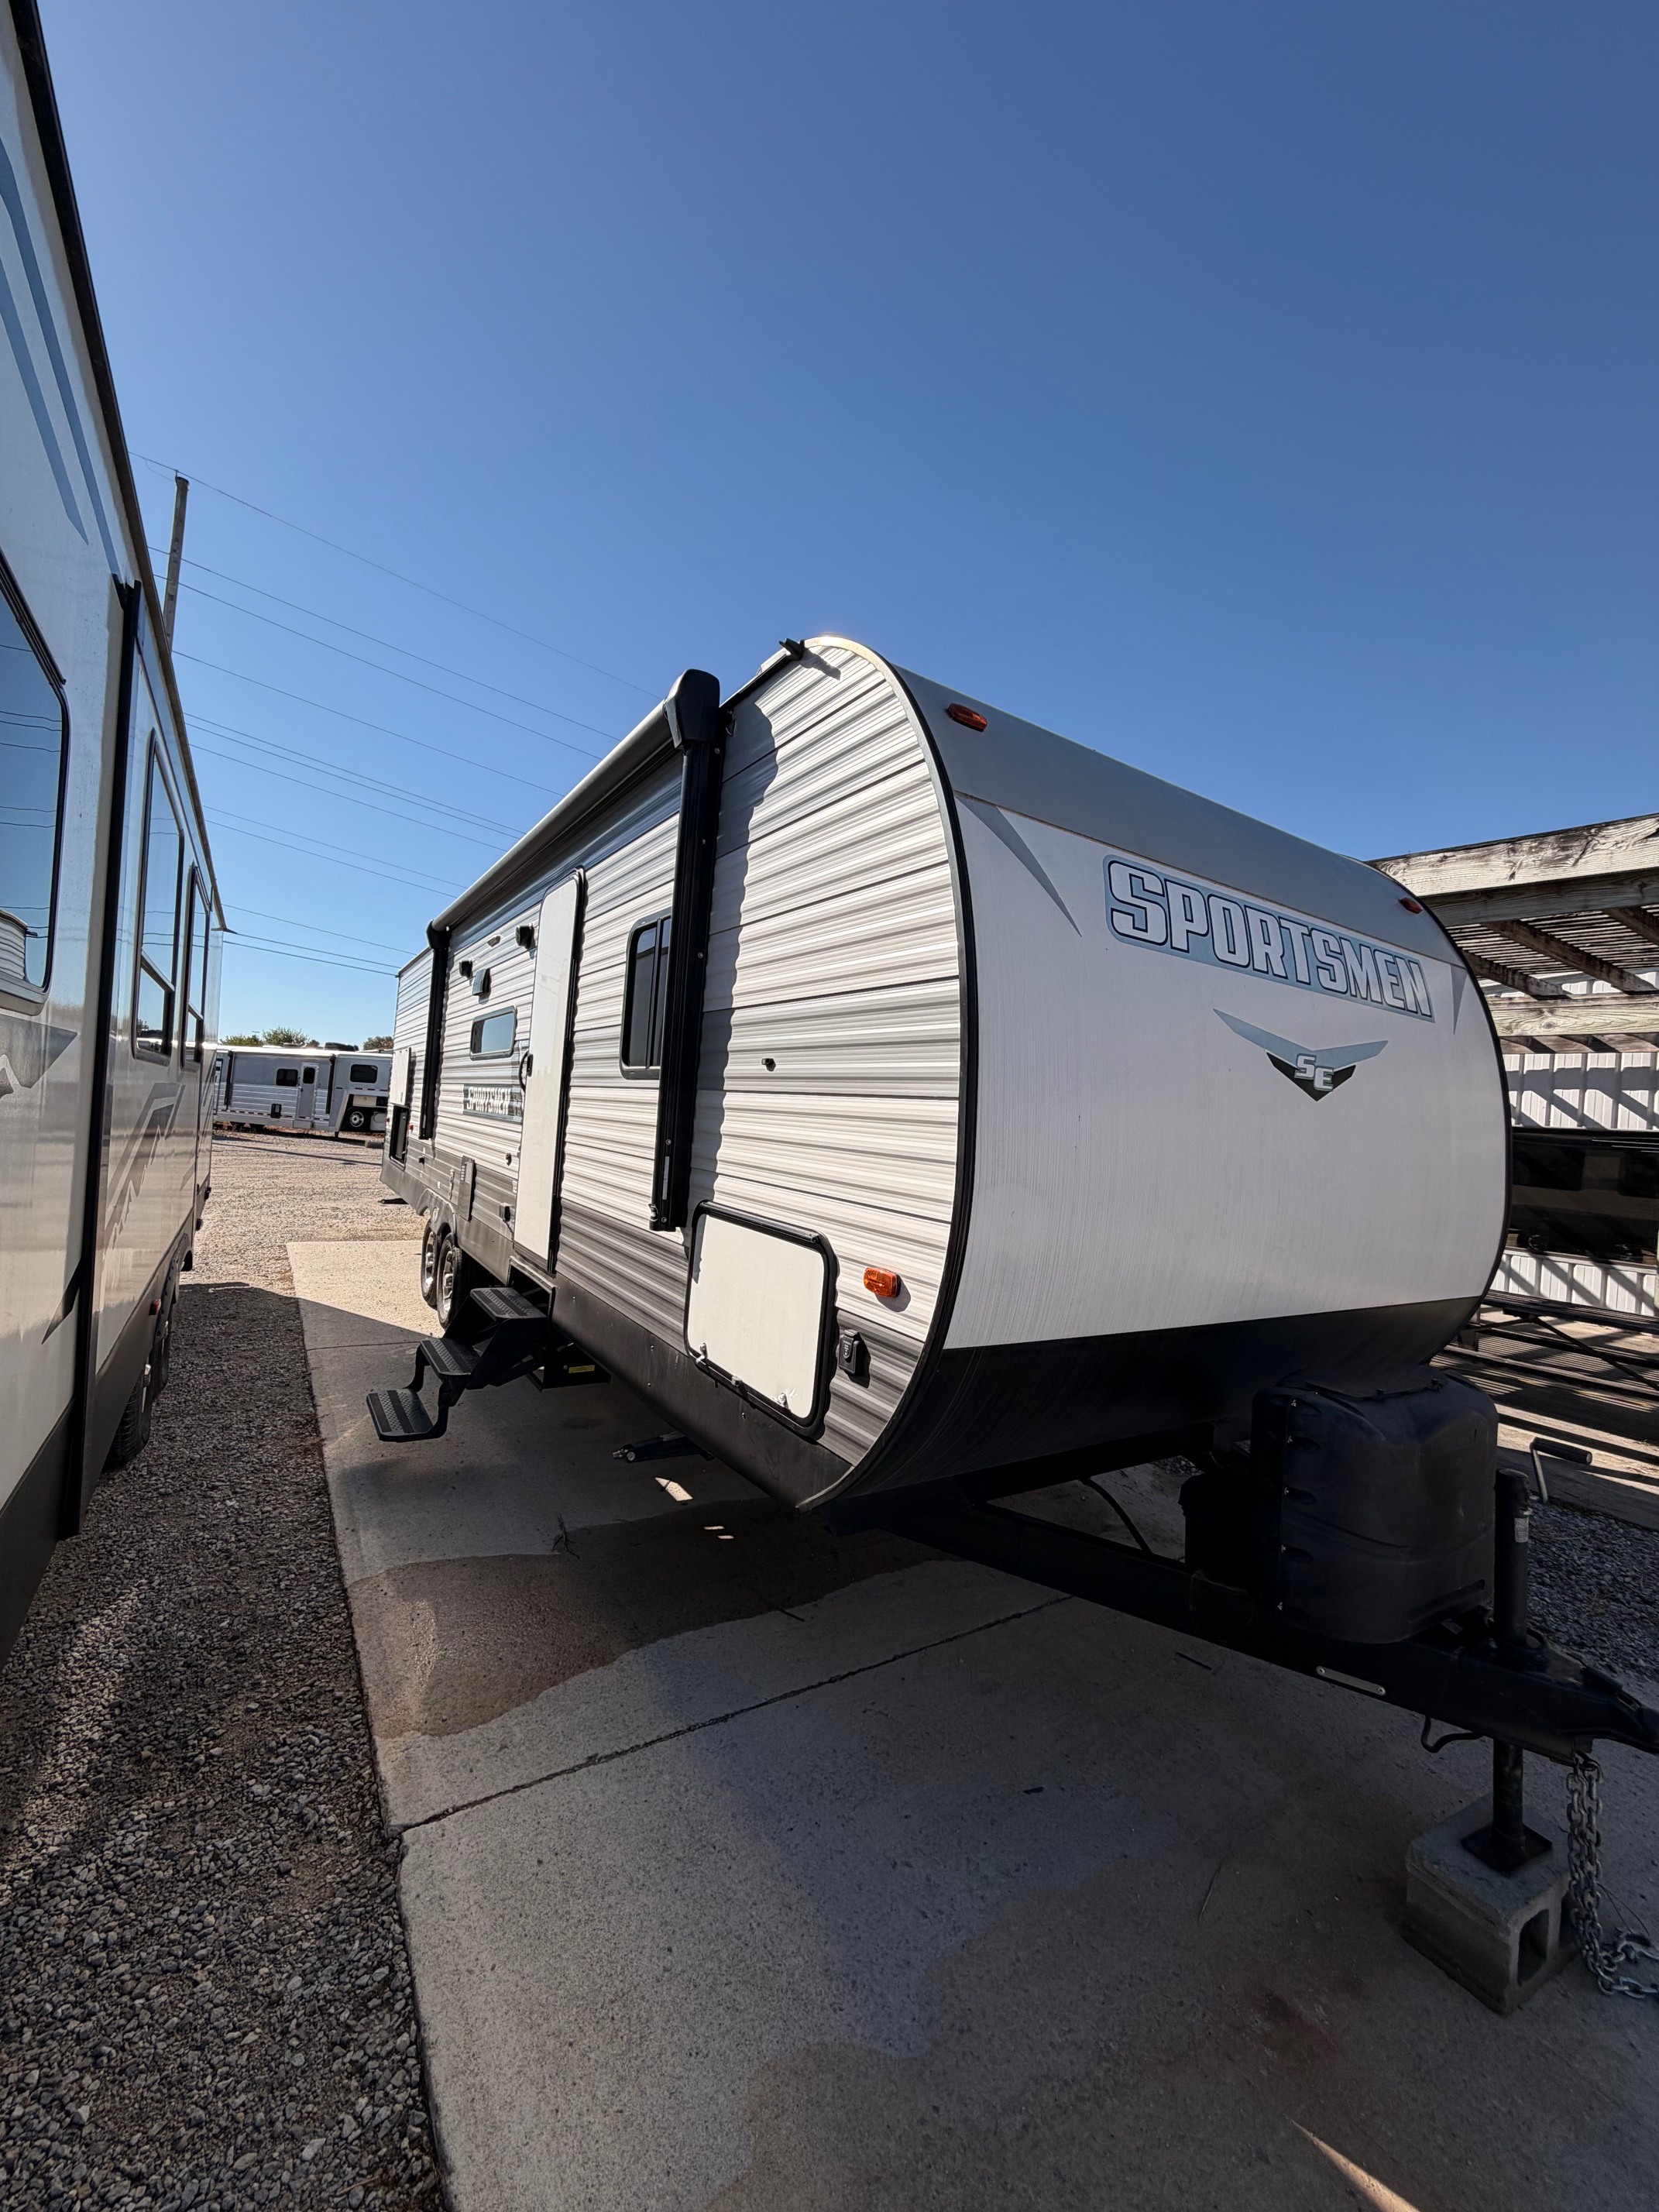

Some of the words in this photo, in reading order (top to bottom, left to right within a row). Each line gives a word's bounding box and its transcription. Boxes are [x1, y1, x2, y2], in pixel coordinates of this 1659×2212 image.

[1108, 860, 1432, 1018] SPORTSMEN
[1294, 1053, 1334, 1091] SE
[466, 1087, 511, 1115] SPORTSMEN
